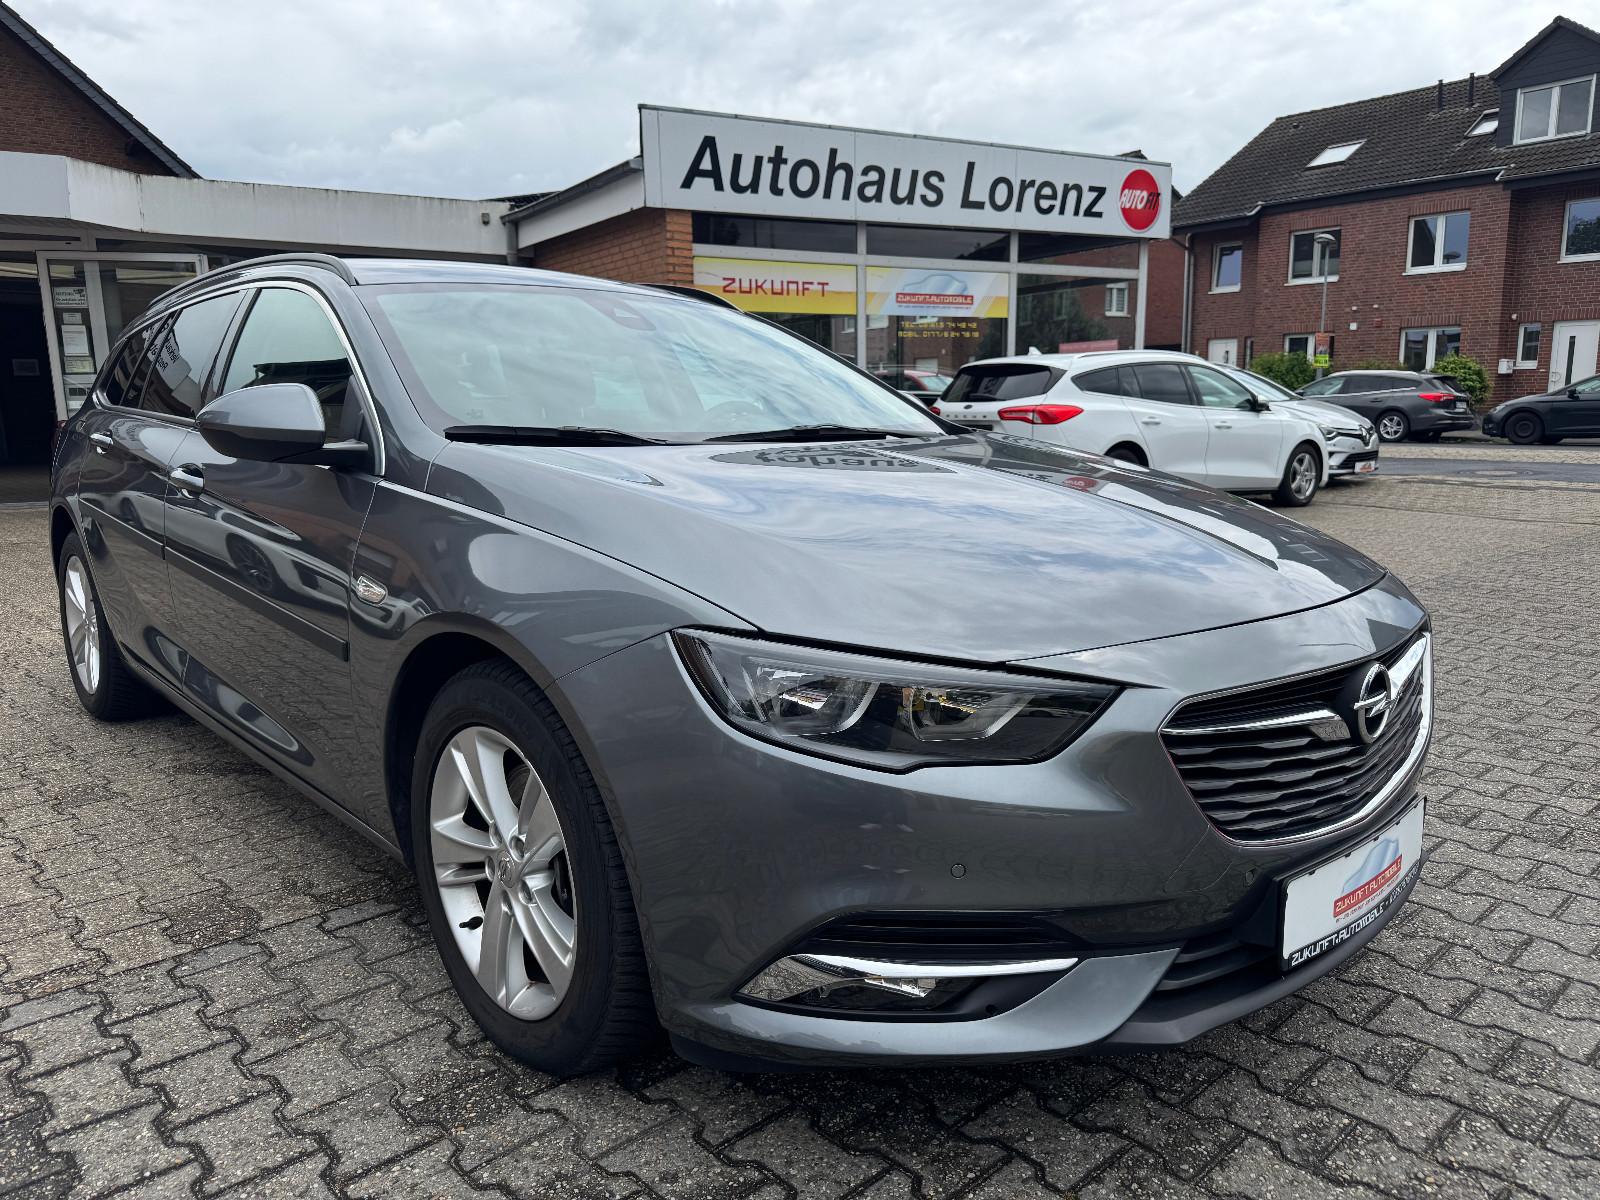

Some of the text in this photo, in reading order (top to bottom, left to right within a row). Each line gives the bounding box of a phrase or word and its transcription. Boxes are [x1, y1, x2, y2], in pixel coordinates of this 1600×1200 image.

[680, 135, 1107, 218] Autohaus Lorenz
[722, 277, 829, 297] ZUKUNFT
